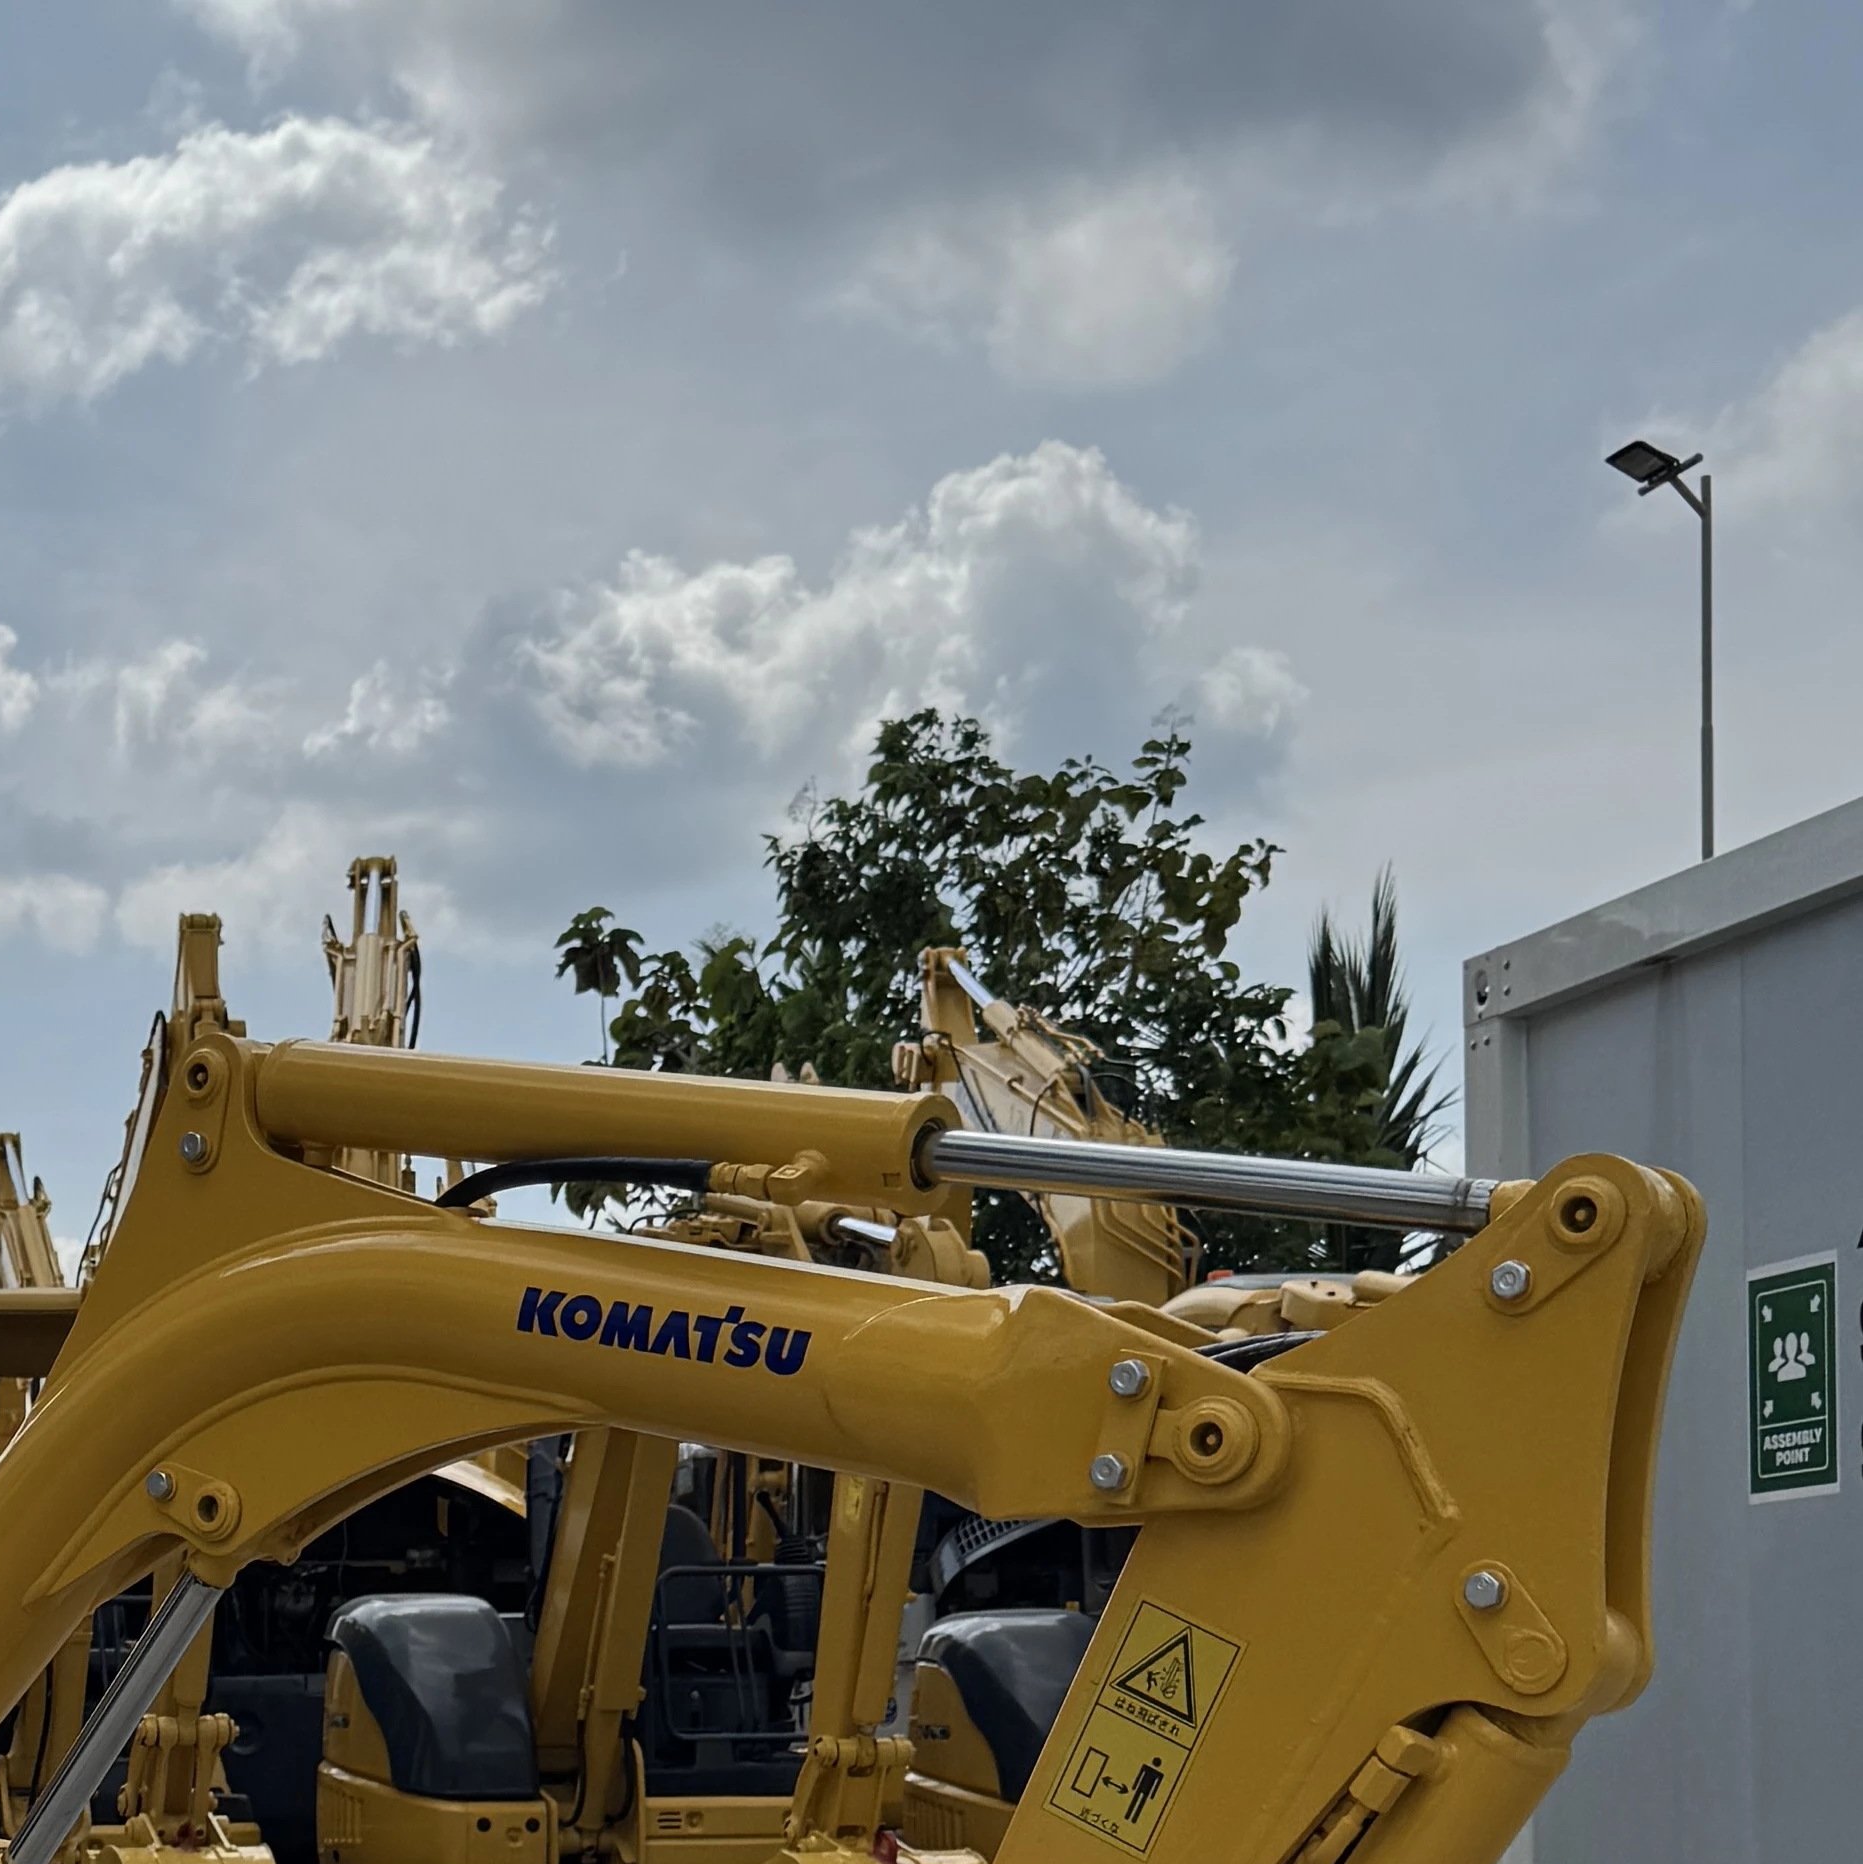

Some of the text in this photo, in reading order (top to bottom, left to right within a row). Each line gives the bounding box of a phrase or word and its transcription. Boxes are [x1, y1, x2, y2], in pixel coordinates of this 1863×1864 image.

[516, 1287, 812, 1376] KOMATSU
[1763, 1427, 1823, 1451] ASSEMBLY
[1776, 1447, 1811, 1467] POINT
